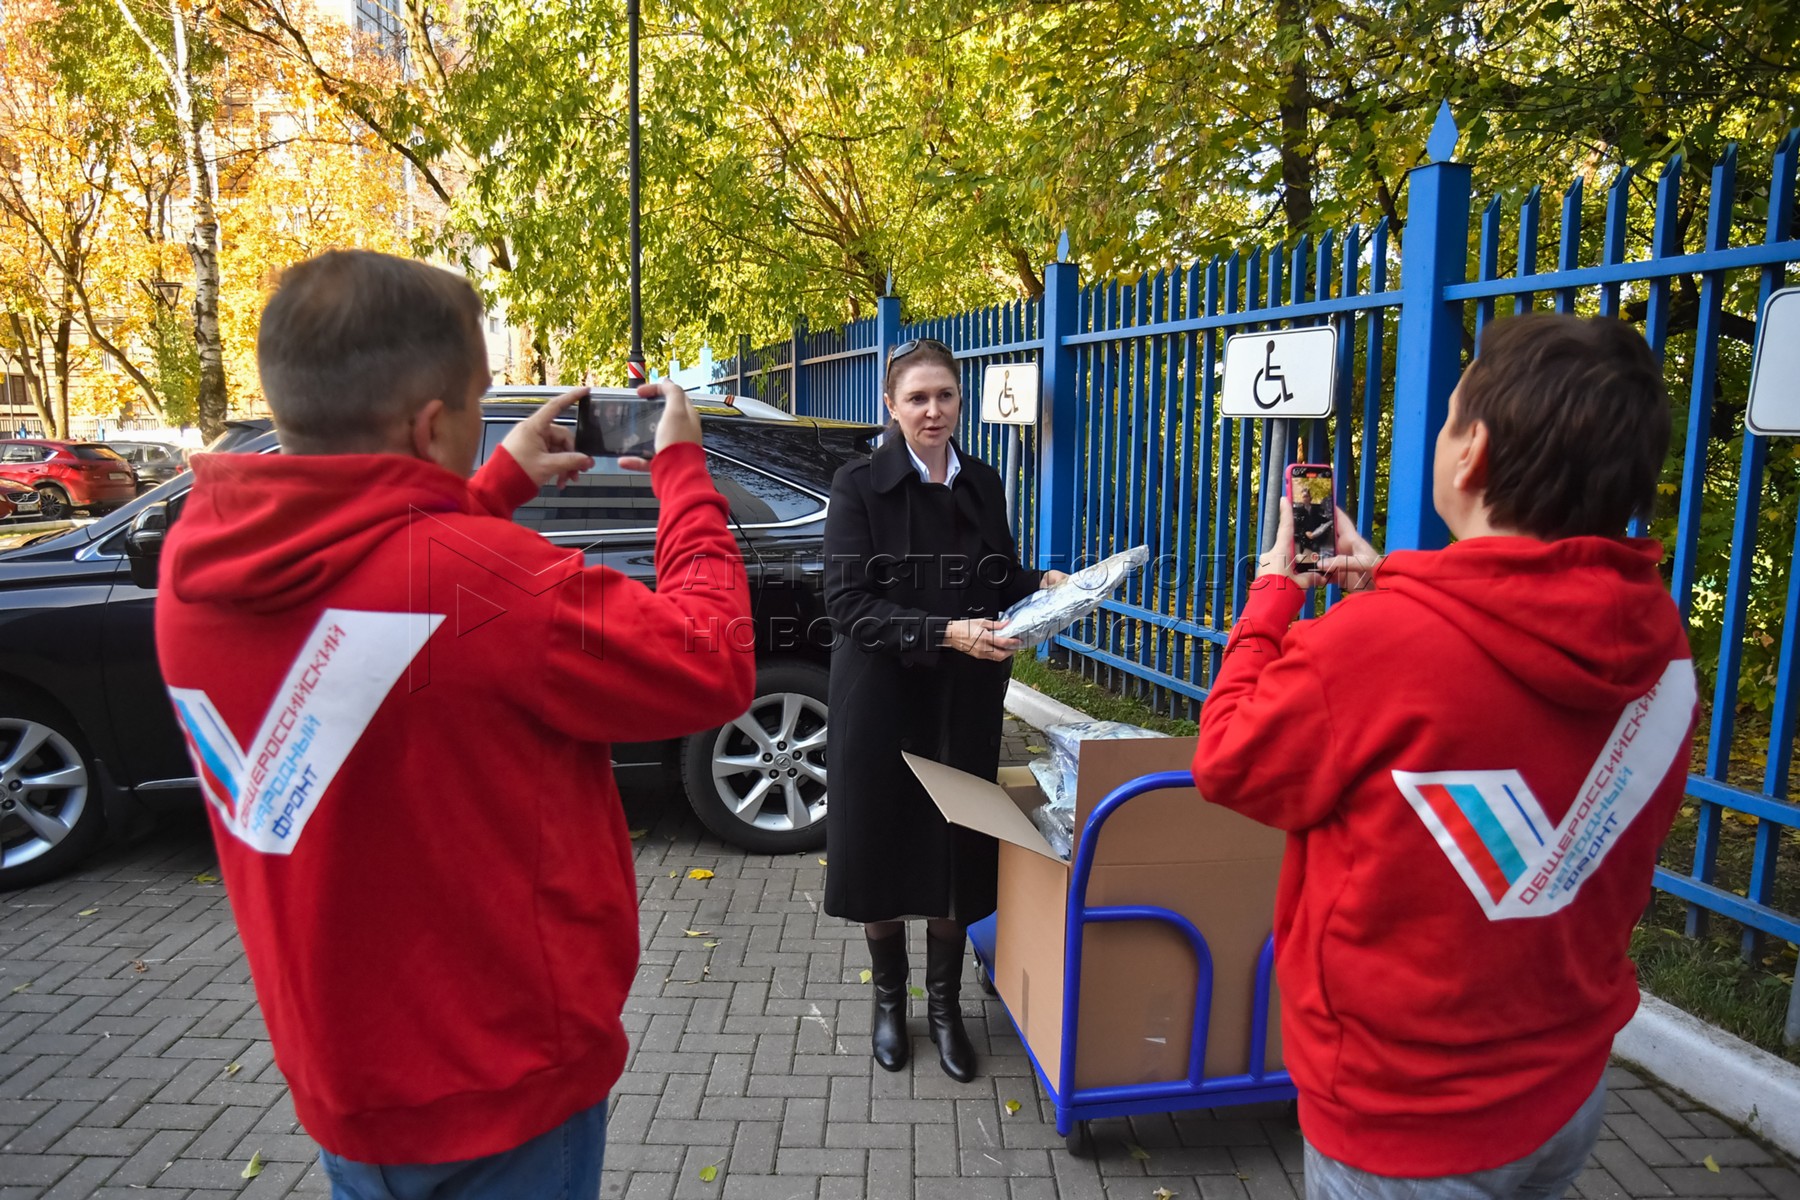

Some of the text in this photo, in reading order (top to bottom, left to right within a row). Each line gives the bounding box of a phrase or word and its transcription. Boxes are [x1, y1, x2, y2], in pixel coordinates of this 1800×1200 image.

[251, 713, 322, 832] НАРОДНЫЙ
[271, 764, 318, 839] ФРОНТ
[1547, 767, 1633, 899] НАРОДНЫЙ
[1562, 811, 1618, 892] ФРОНТ
